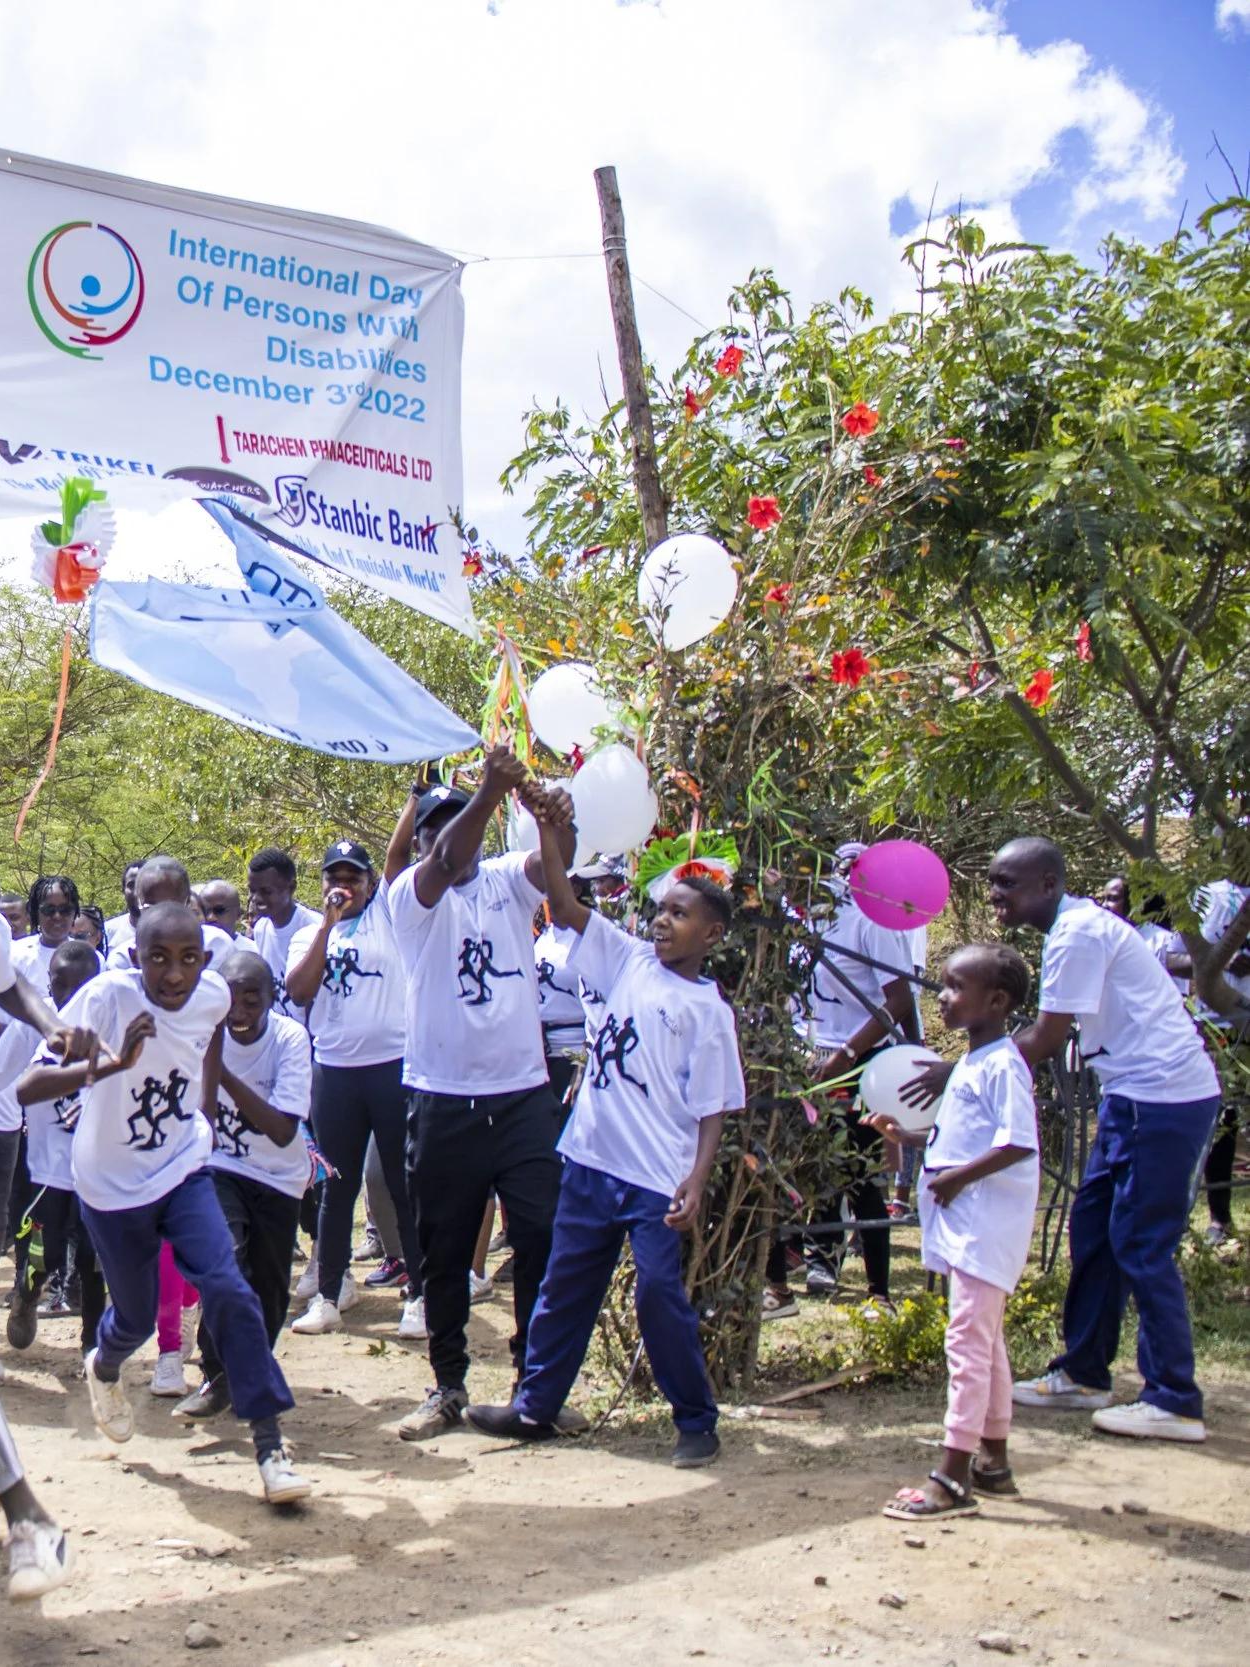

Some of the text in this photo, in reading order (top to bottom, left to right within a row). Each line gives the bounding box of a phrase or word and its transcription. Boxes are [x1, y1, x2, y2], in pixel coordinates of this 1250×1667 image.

[169, 229, 422, 309] International Day
[177, 275, 419, 343] Of Persons With
[150, 355, 315, 406] December
[358, 386, 426, 423] 2022
[233, 431, 308, 458] TARACHEM
[411, 457, 433, 482] LTD
[306, 490, 440, 556] Stanbic Bank
[346, 549, 403, 584] Equitable
